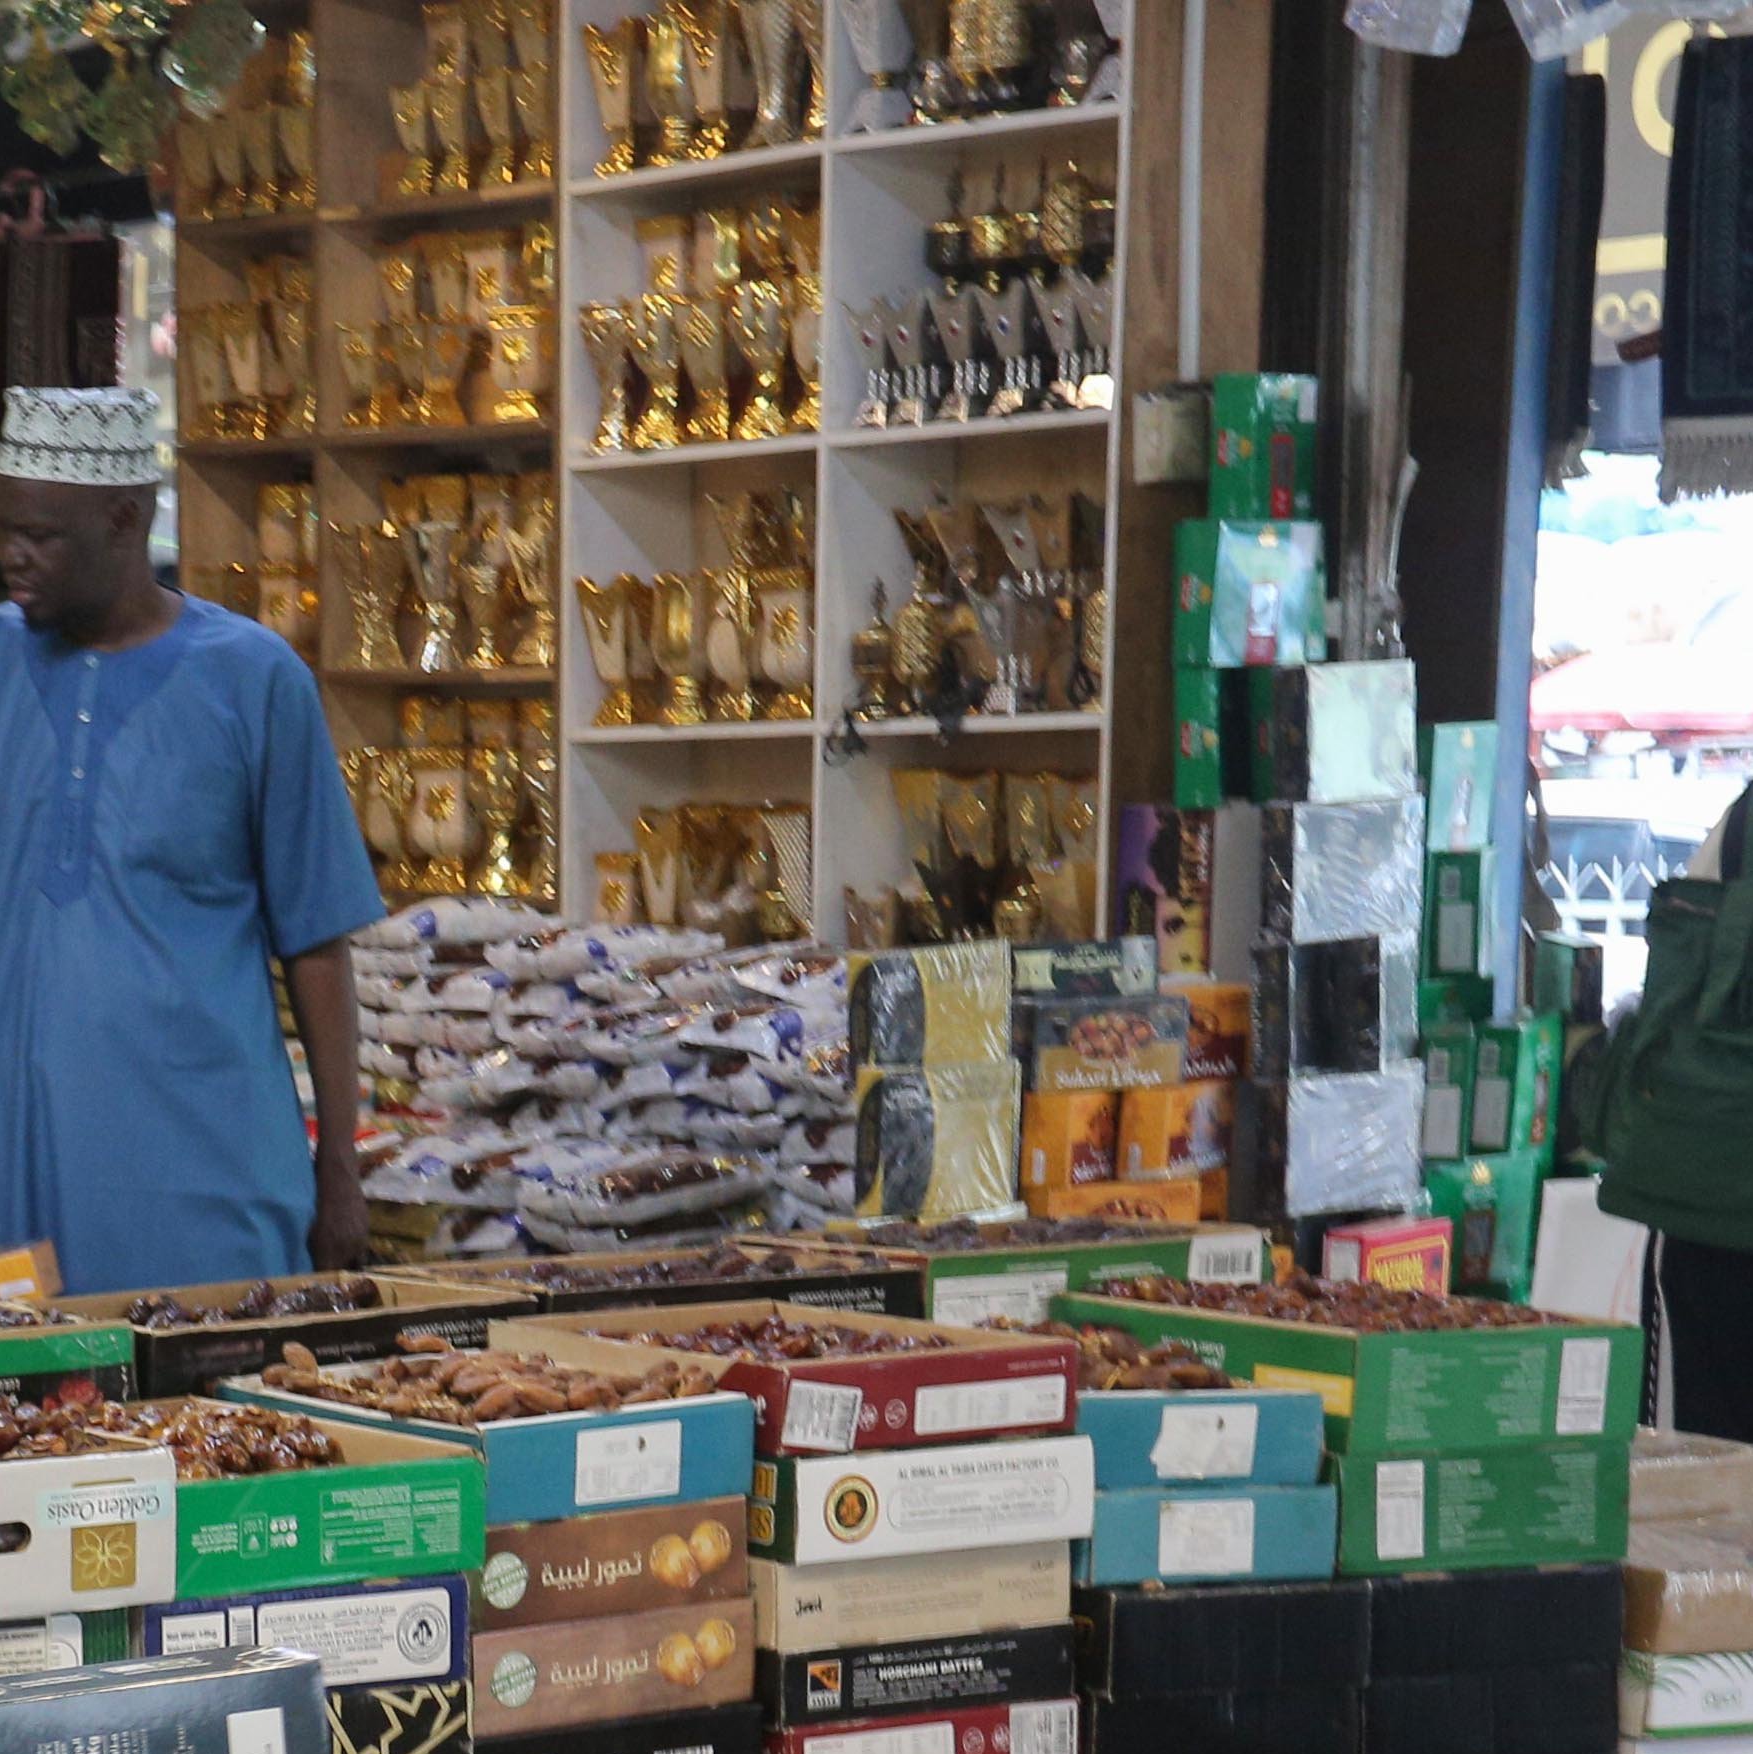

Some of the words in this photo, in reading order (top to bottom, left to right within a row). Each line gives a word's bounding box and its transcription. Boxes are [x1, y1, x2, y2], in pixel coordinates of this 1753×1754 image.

[47, 1501, 94, 1525] Oasis
[97, 1495, 160, 1520] Golden
[594, 1552, 642, 1587] تمور
